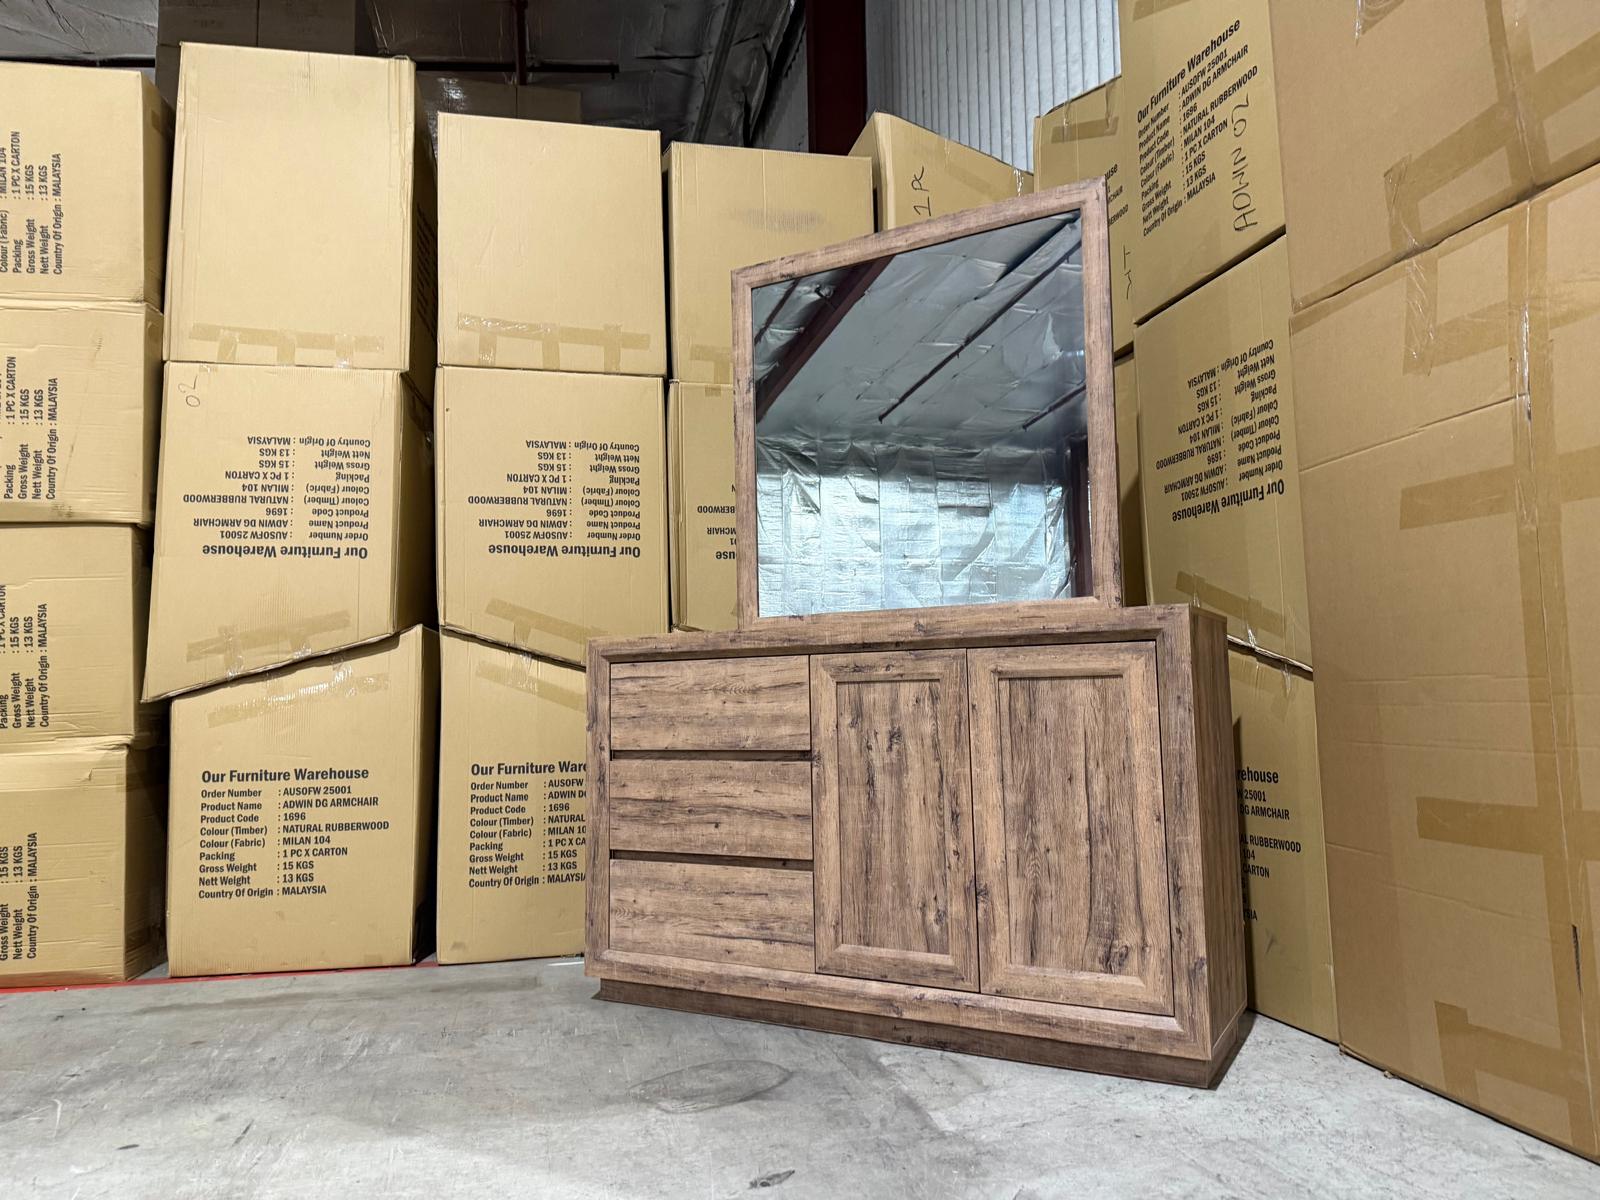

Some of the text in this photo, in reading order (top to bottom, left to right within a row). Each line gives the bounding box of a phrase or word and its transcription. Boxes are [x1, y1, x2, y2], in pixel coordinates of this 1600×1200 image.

[1211, 43, 1248, 83] ARMCHAIR
[1136, 19, 1240, 124] Our Furniture Warehouse
[1181, 47, 1228, 97] AUSOFW 25001
[1182, 64, 1258, 135] NATURAL RUBBERWOOD
[1187, 173, 1216, 200] MALAYSIA
[23, 164, 37, 274] Gross Weight 15 KGS
[37, 164, 51, 275] Nett Weight 13 KGS
[51, 152, 65, 275] Country Of Origin MALAYSIA
[17, 388, 31, 499] Gross Weight 15 KGS
[31, 388, 44, 500] Nett Weight 13 KGS
[45, 377, 59, 500] Country Of Origin MALAYSIA
[246, 435, 371, 448] Country Of Origin MALAYSIA
[525, 439, 640, 453] Country Of Origin MALAYSIA
[1155, 437, 1222, 470] NATURAL RUBBERWOOD
[241, 482, 370, 495] Colour (Fabric) MILAN 104
[1163, 474, 1194, 494] ARMCHAIR
[1180, 459, 1283, 502] Order Number AUSOFW 25001
[182, 493, 370, 507] Colour (Timber) NATURAL RUBBERWOOD
[467, 495, 641, 508] Colour (Timber) NATURAL RUBBERWOOD
[1171, 478, 1285, 522] Our Furniture Warehouse
[265, 507, 369, 518] Product Code 1696
[192, 517, 369, 530] Product Name ADWIN DG ARMCHAIR
[478, 518, 641, 530] Product Name ADWIN DG ARMCHAIR
[219, 530, 369, 541] Order Number AUSOFW 25001
[504, 530, 641, 541] Order Number AUSOFW 25001
[202, 544, 368, 560] Our Furniture Warehouse
[487, 543, 641, 558] Our Furniture Warehouse
[9, 616, 23, 729] Gross Weight 15 KGS
[36, 602, 50, 728] Country Of Origin MALAYSIA
[201, 767, 369, 783] Our Furniture Warehouse
[470, 761, 556, 776] Our Furniture
[200, 784, 352, 799] Order Number AUSOFW 25001
[470, 778, 584, 791] Order Number AUSOFW
[200, 796, 379, 811] Product Name ADWIN DG ARMCHAIR
[1244, 789, 1267, 803] 25001
[200, 811, 306, 824] Product Code 1696
[469, 813, 586, 827] Colour (Timber) NATURAL
[1251, 804, 1290, 821] ARMCHAIR
[199, 820, 389, 837] Colour (Timber) NATURAL RUBBERWOOD
[199, 834, 331, 849] Colour (Fabric) MILAN 104
[1250, 834, 1302, 854] RUBBERWOOD
[26, 831, 40, 959] Country Of Origin MALAYSIA
[198, 884, 327, 900] Country Of Origin MALAYSIA
[12, 845, 25, 960] Nett Weight 13 KGS
